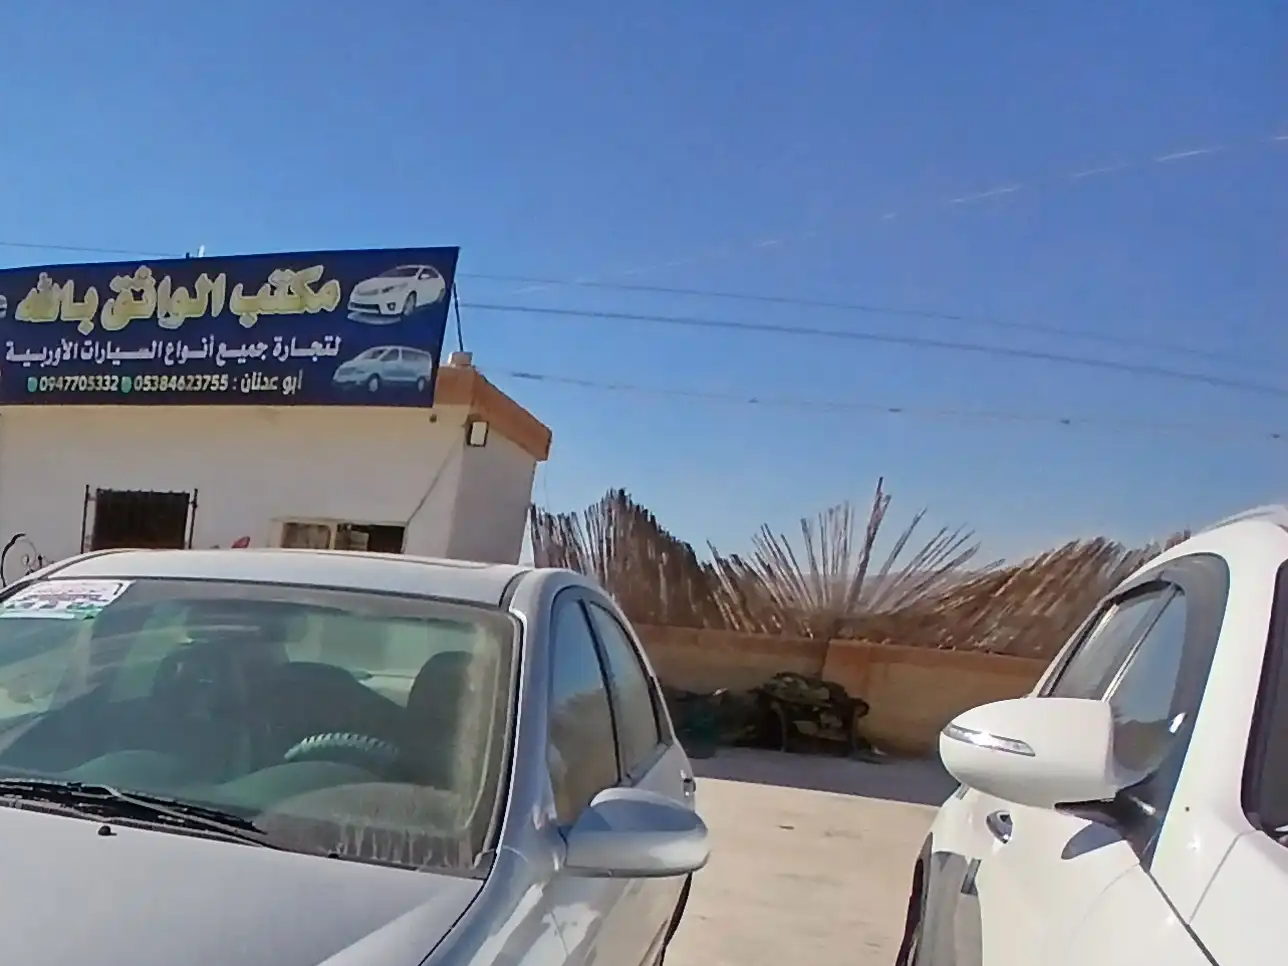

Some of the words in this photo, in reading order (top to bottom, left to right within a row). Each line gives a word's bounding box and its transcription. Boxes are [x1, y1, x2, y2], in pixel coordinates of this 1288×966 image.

[15, 272, 99, 335] بالله
[101, 266, 227, 331] الواثق
[230, 265, 342, 328] مكتب
[5, 338, 79, 368] الأوربية
[80, 339, 163, 366] السيارات
[164, 334, 215, 366] أنواع
[215, 341, 269, 367] جميع
[272, 335, 342, 362] لتجارة
[39, 375, 119, 392] 0947705332
[133, 373, 229, 392] 05384623755
[240, 371, 279, 394] عدنان
